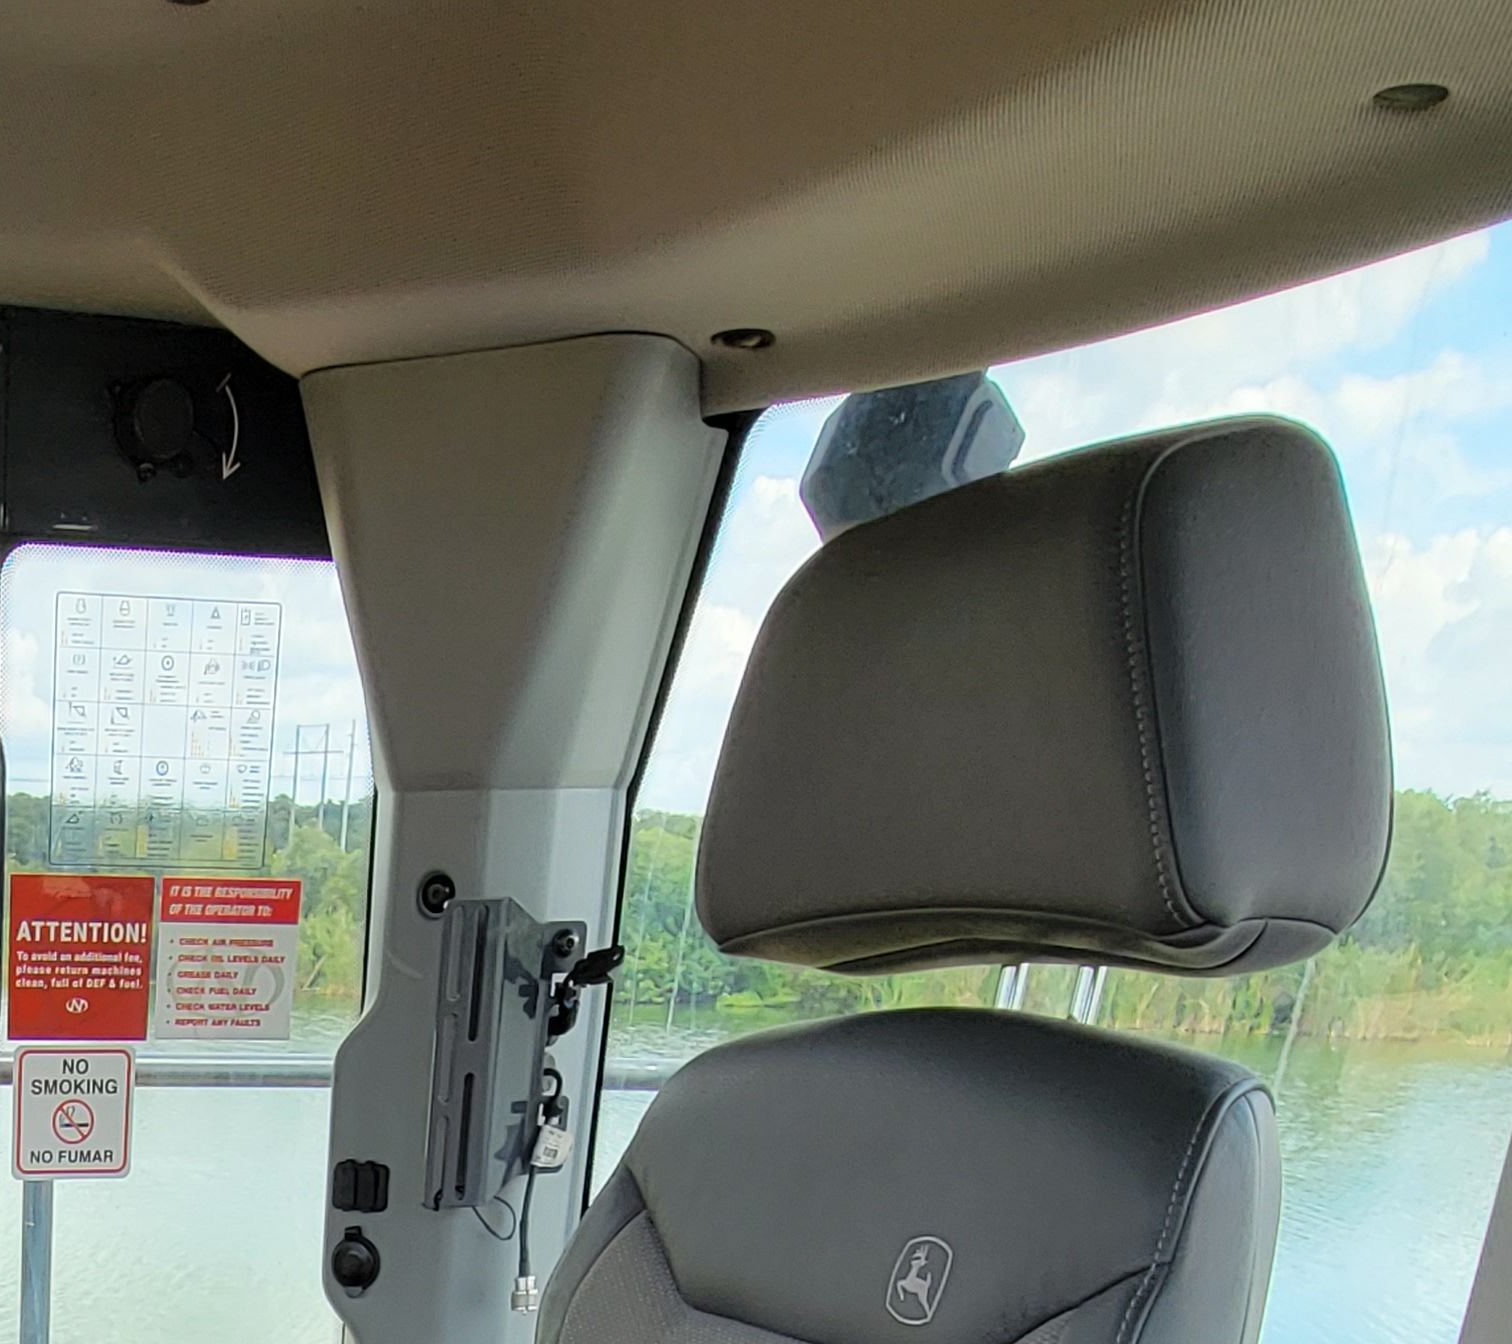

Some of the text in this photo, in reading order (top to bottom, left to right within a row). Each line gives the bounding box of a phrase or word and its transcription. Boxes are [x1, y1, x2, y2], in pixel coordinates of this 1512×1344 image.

[16, 920, 147, 943] ATTENTION!
[16, 951, 29, 961] To
[31, 951, 57, 961] avoid
[60, 953, 72, 962] an
[74, 951, 123, 962] additional
[15, 964, 142, 976] please return machines
[51, 978, 69, 988] full
[86, 979, 106, 989] DEF
[62, 1058, 89, 1074] NO
[31, 1079, 118, 1095] SMOKING
[30, 1150, 113, 1164] NO FUMAR
